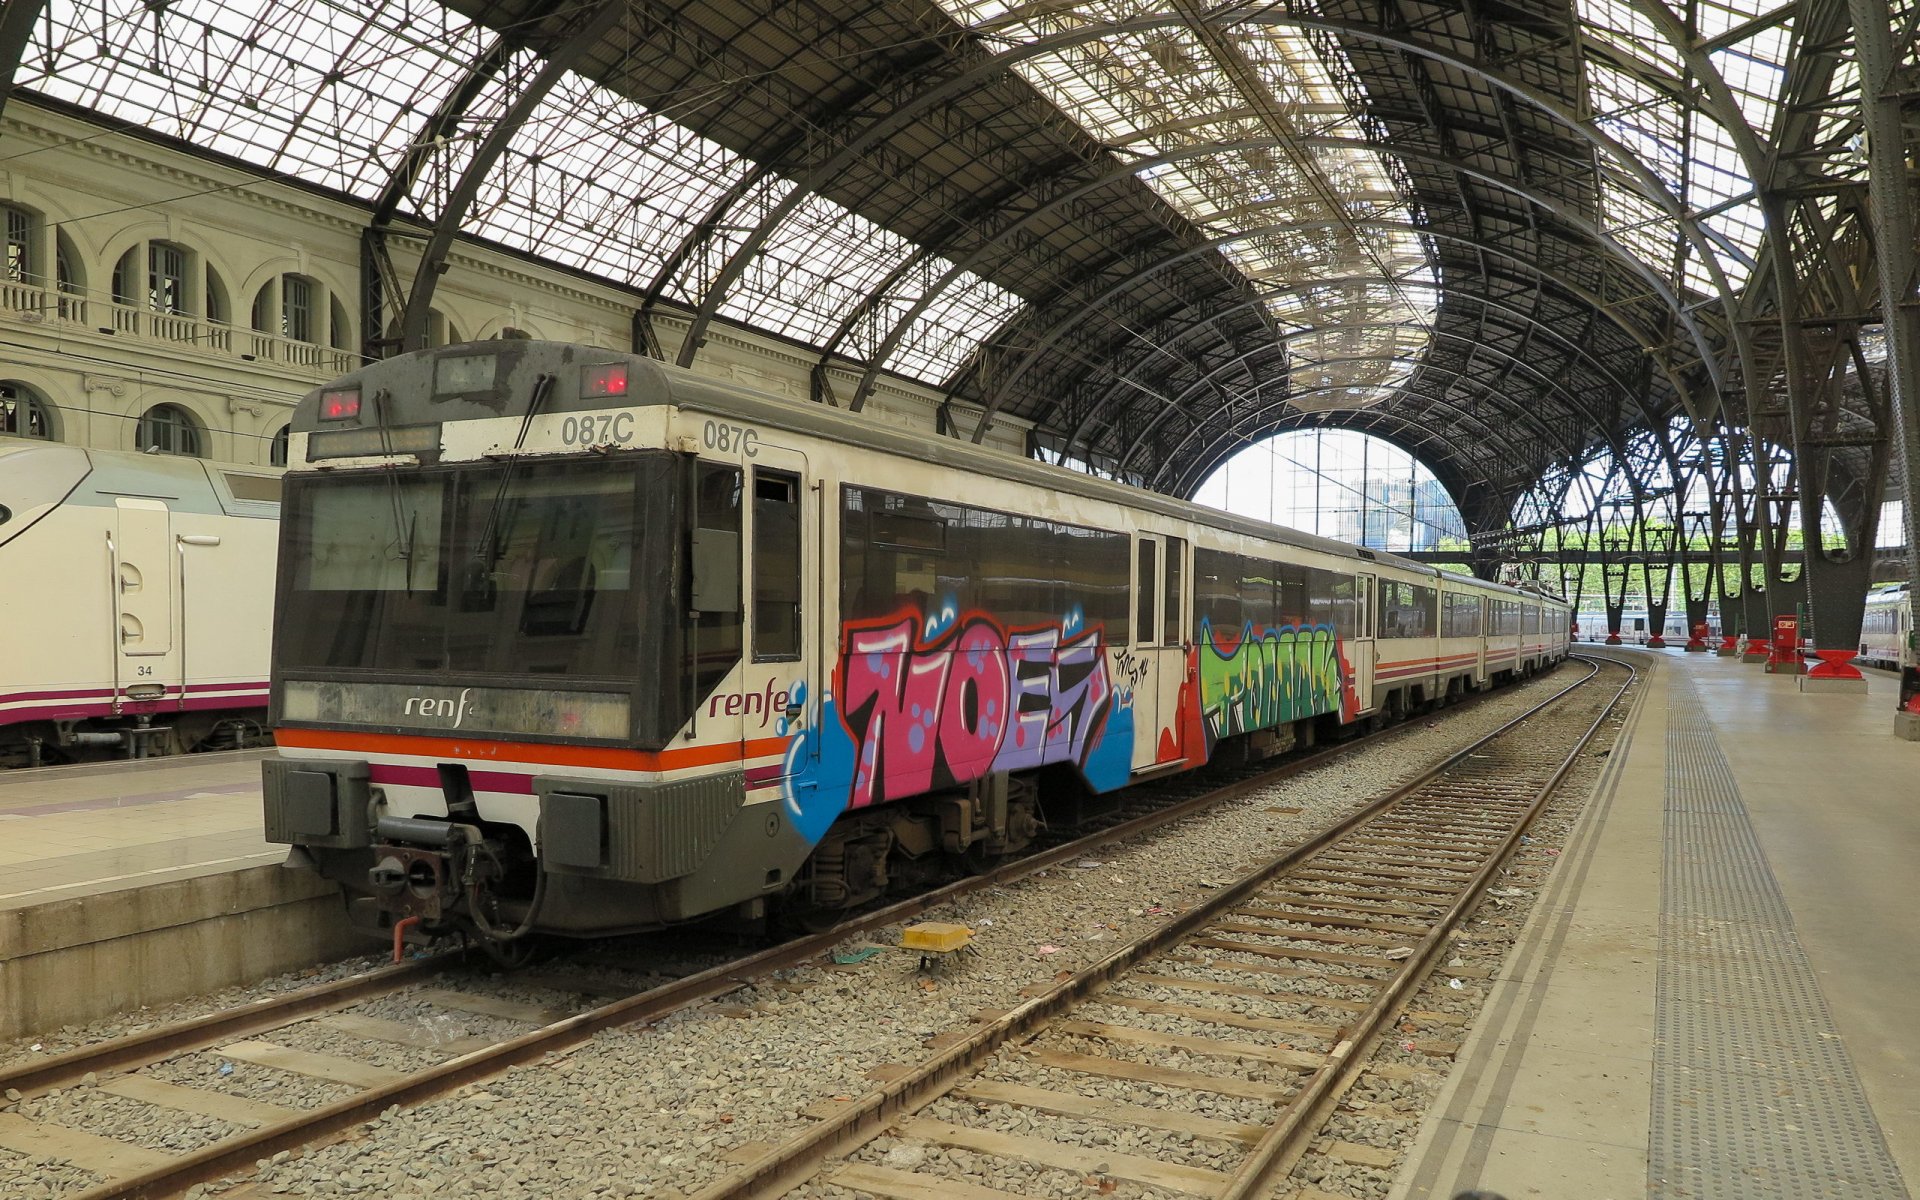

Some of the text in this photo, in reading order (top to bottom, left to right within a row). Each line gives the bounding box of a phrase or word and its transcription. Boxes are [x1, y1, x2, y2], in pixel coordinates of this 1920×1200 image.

[562, 412, 635, 446] 087C
[703, 420, 759, 458] 087C
[137, 666, 153, 676] 34
[404, 687, 473, 729] renf
[709, 676, 790, 729] renfe
